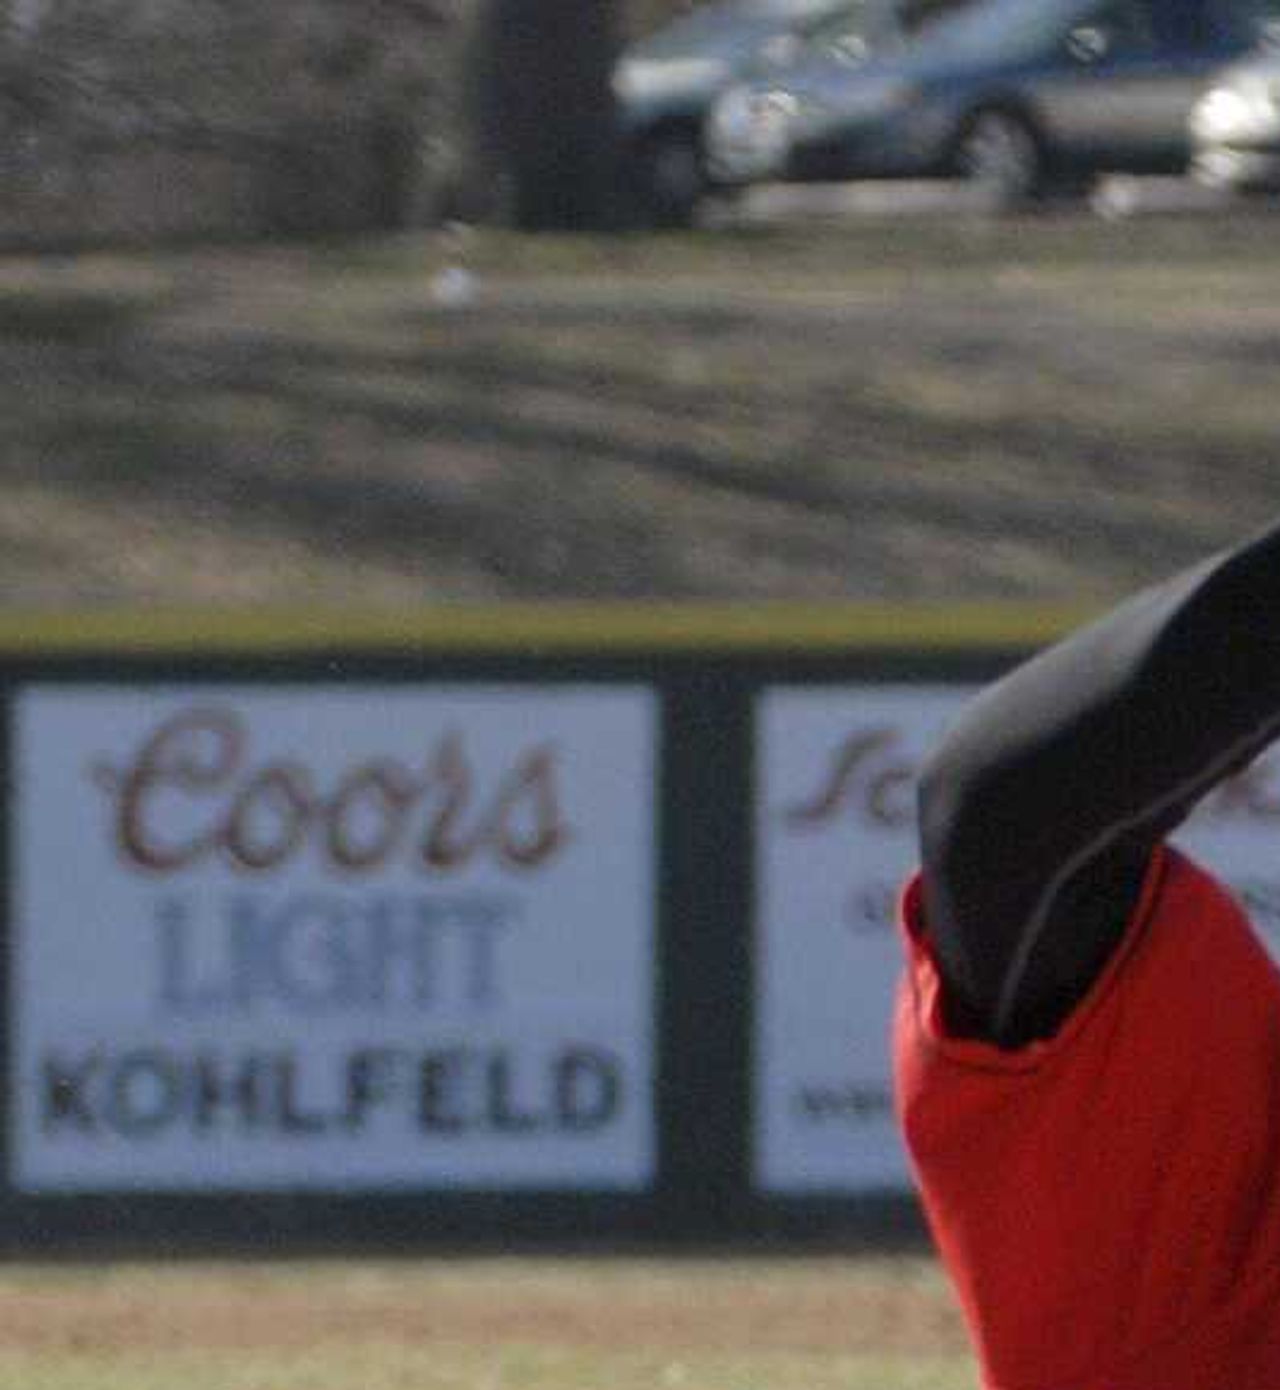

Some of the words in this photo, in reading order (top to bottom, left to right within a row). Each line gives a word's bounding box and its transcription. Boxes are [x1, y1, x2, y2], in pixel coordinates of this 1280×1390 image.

[88, 708, 570, 872] Coors
[155, 895, 520, 1005] LIGHT
[42, 1042, 624, 1138] KOHLFELD
